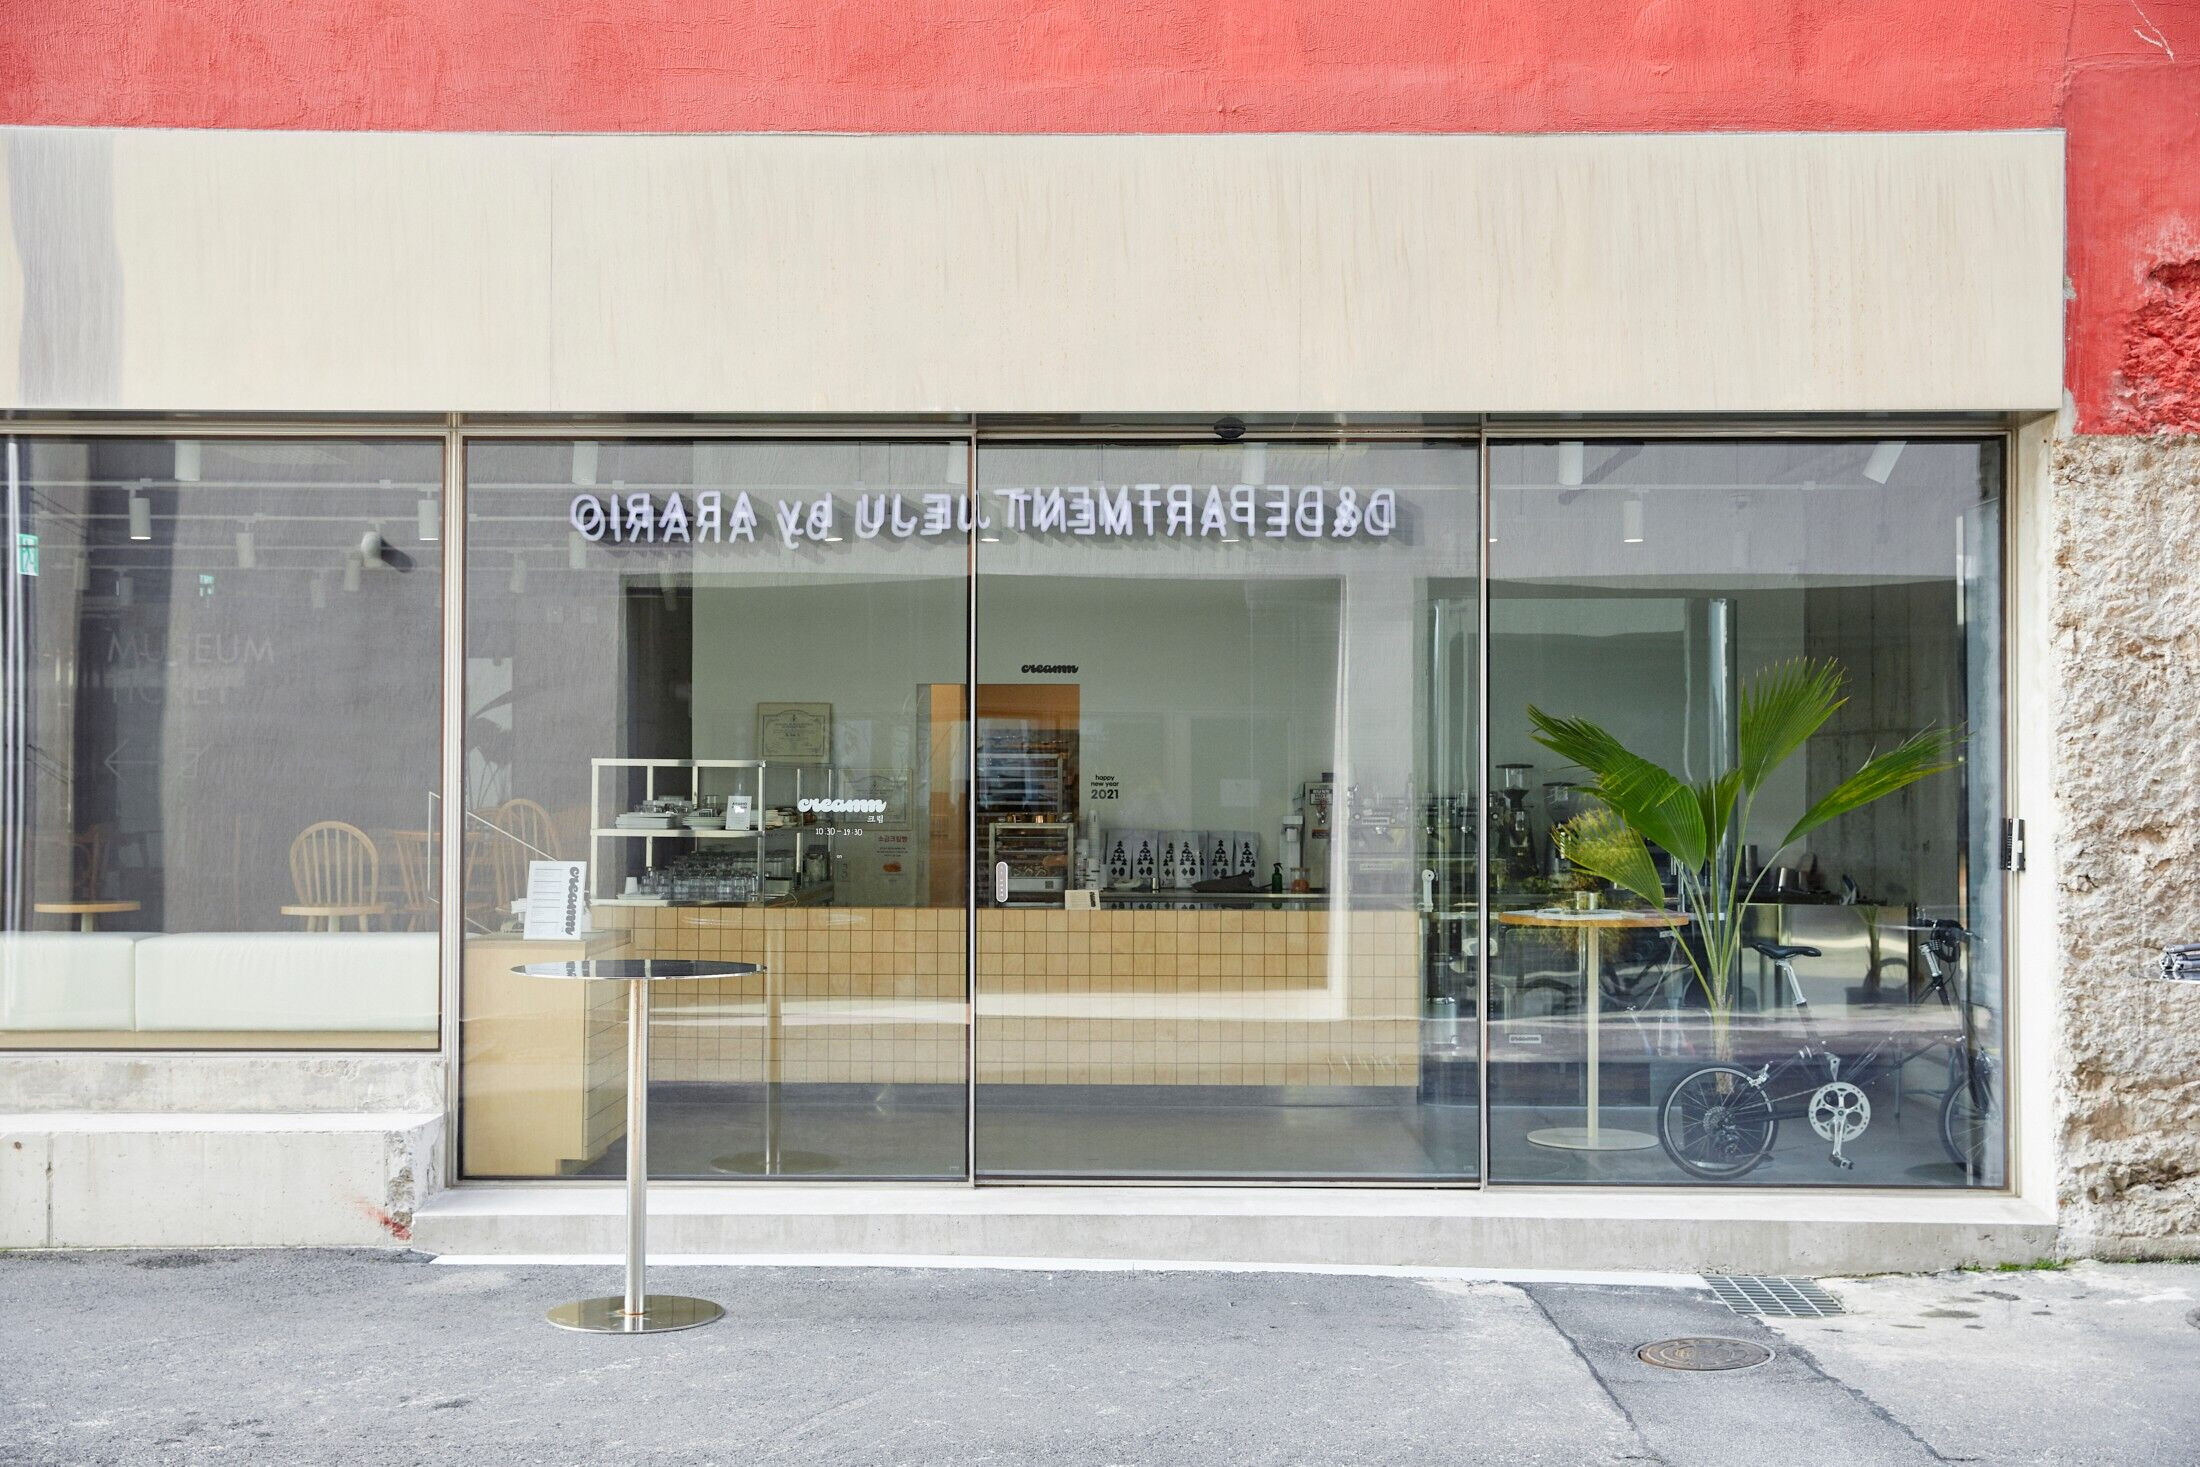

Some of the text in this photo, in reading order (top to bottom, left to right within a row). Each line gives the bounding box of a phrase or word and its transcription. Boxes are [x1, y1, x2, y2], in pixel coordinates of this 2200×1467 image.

[1095, 774, 1115, 783] happy
[1091, 789, 1119, 799] 2021
[867, 815, 884, 824] 크림
[843, 828, 863, 836] 19:30
